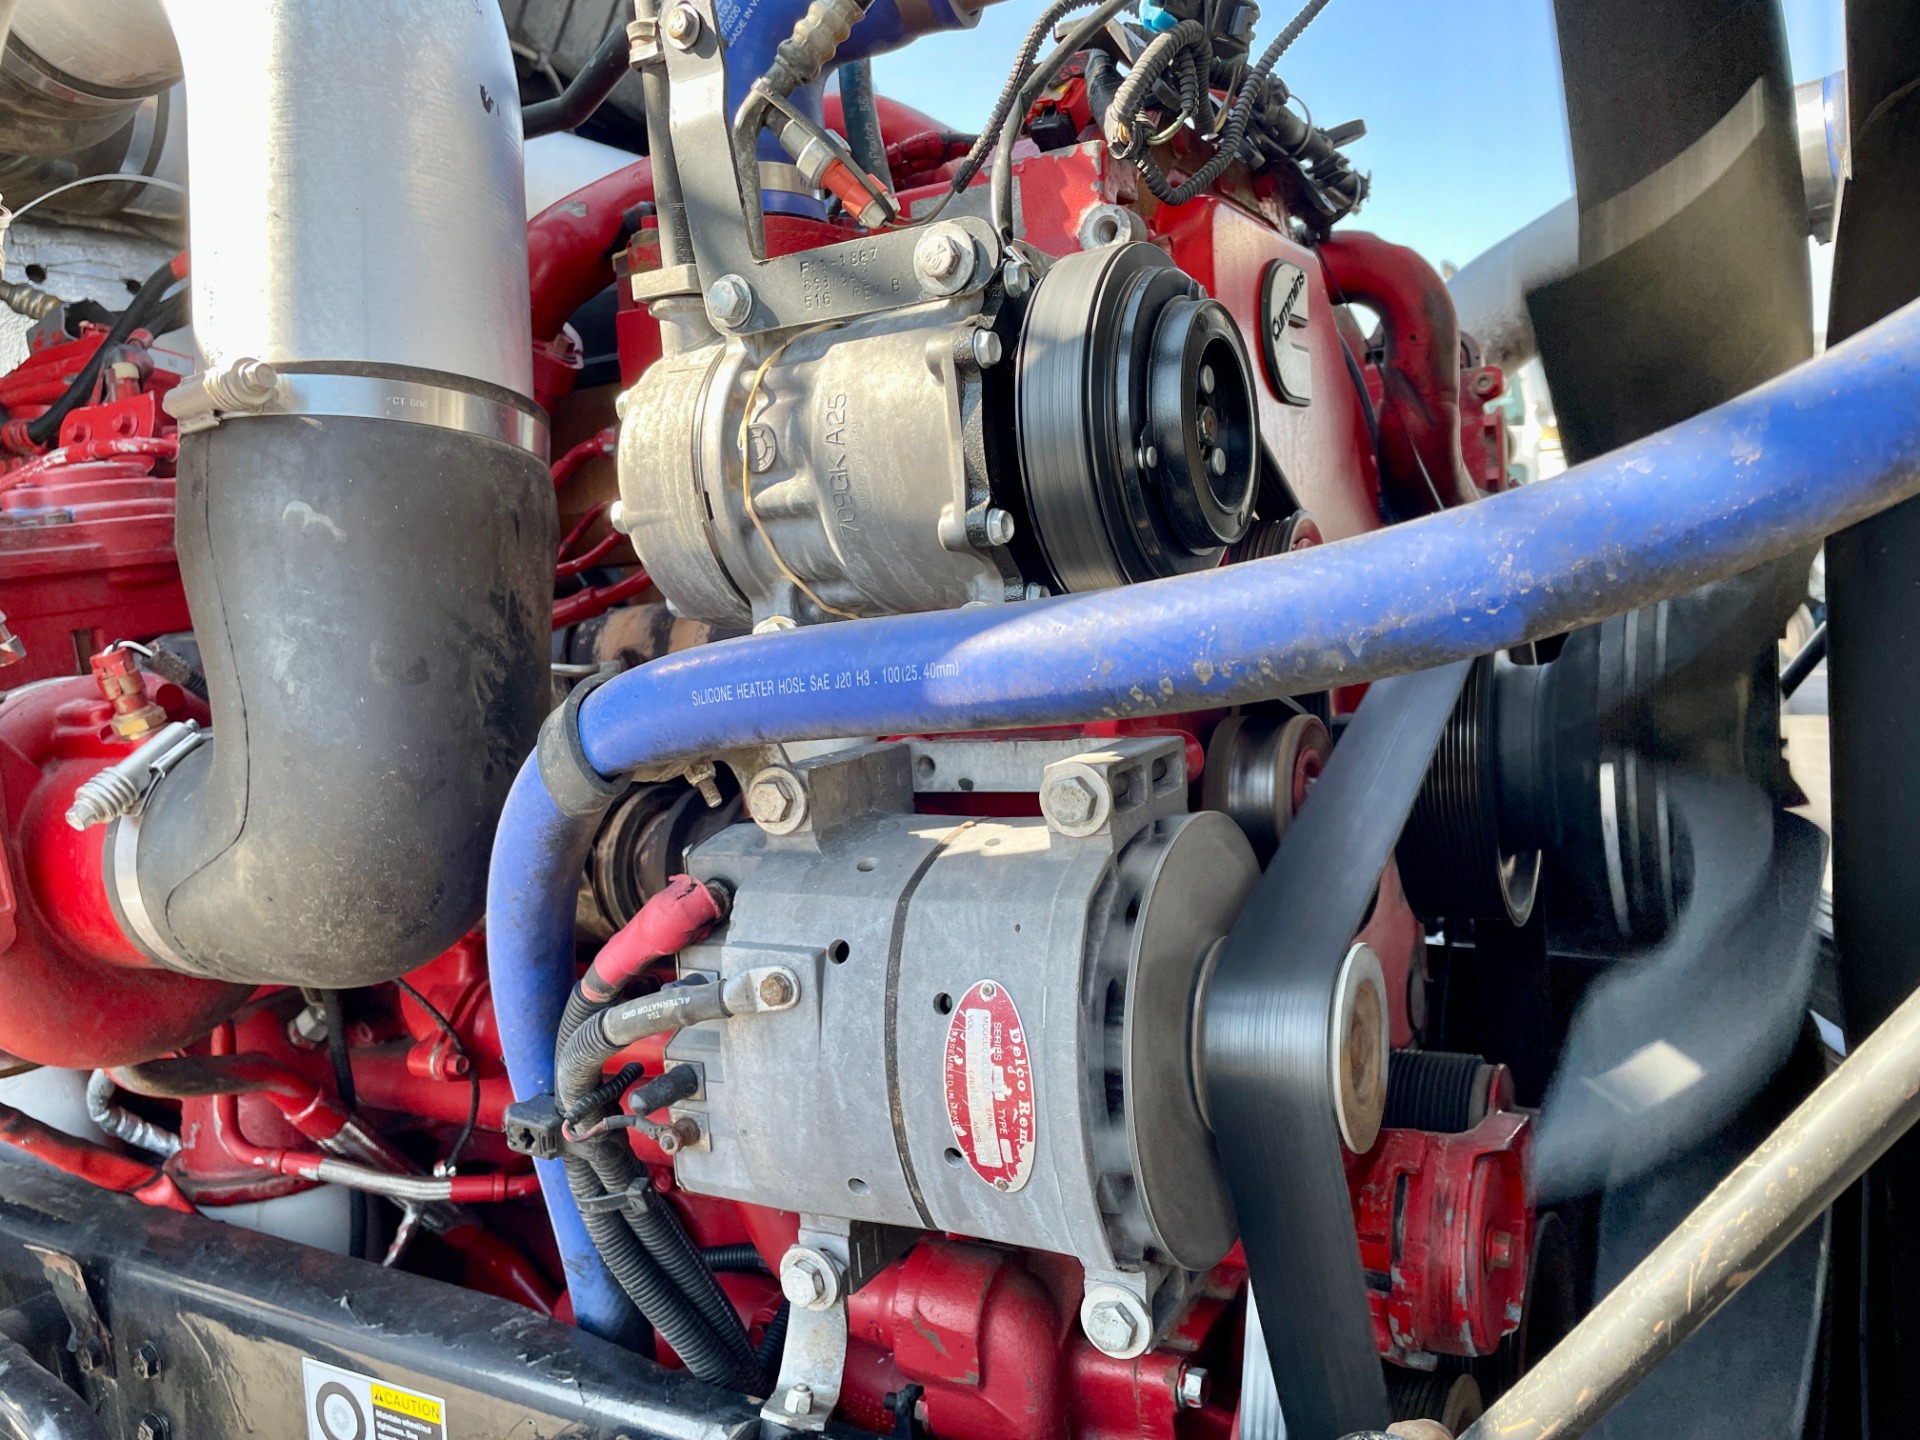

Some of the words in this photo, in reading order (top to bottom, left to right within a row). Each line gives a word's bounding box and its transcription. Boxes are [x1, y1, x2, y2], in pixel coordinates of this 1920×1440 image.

[728, 19, 747, 47] MADE
[743, 7, 753, 19] IN
[891, 277, 901, 293] B
[1272, 270, 1305, 342] Cummins
[392, 396, 406, 406] CT
[691, 685, 734, 706] SILICONE
[736, 679, 775, 700] HEATER
[778, 676, 806, 695] HOSE
[810, 673, 830, 692] SAE
[834, 671, 852, 689] J20
[856, 669, 870, 687] H3
[621, 1009, 637, 1020] GND
[637, 996, 691, 1016] ALTERNATOR
[947, 1030, 958, 1087] ASSEMBLED
[993, 1021, 1002, 1061] SERIES
[1009, 1026, 1026, 1092] Delco
[982, 1015, 990, 1047] MODEL
[986, 1108, 995, 1130] ERIAL
[947, 1089, 955, 1099] IN
[997, 1108, 1008, 1136] TYPE
[1016, 1099, 1031, 1149] Rem
[384, 1391, 440, 1419] CAUTION
